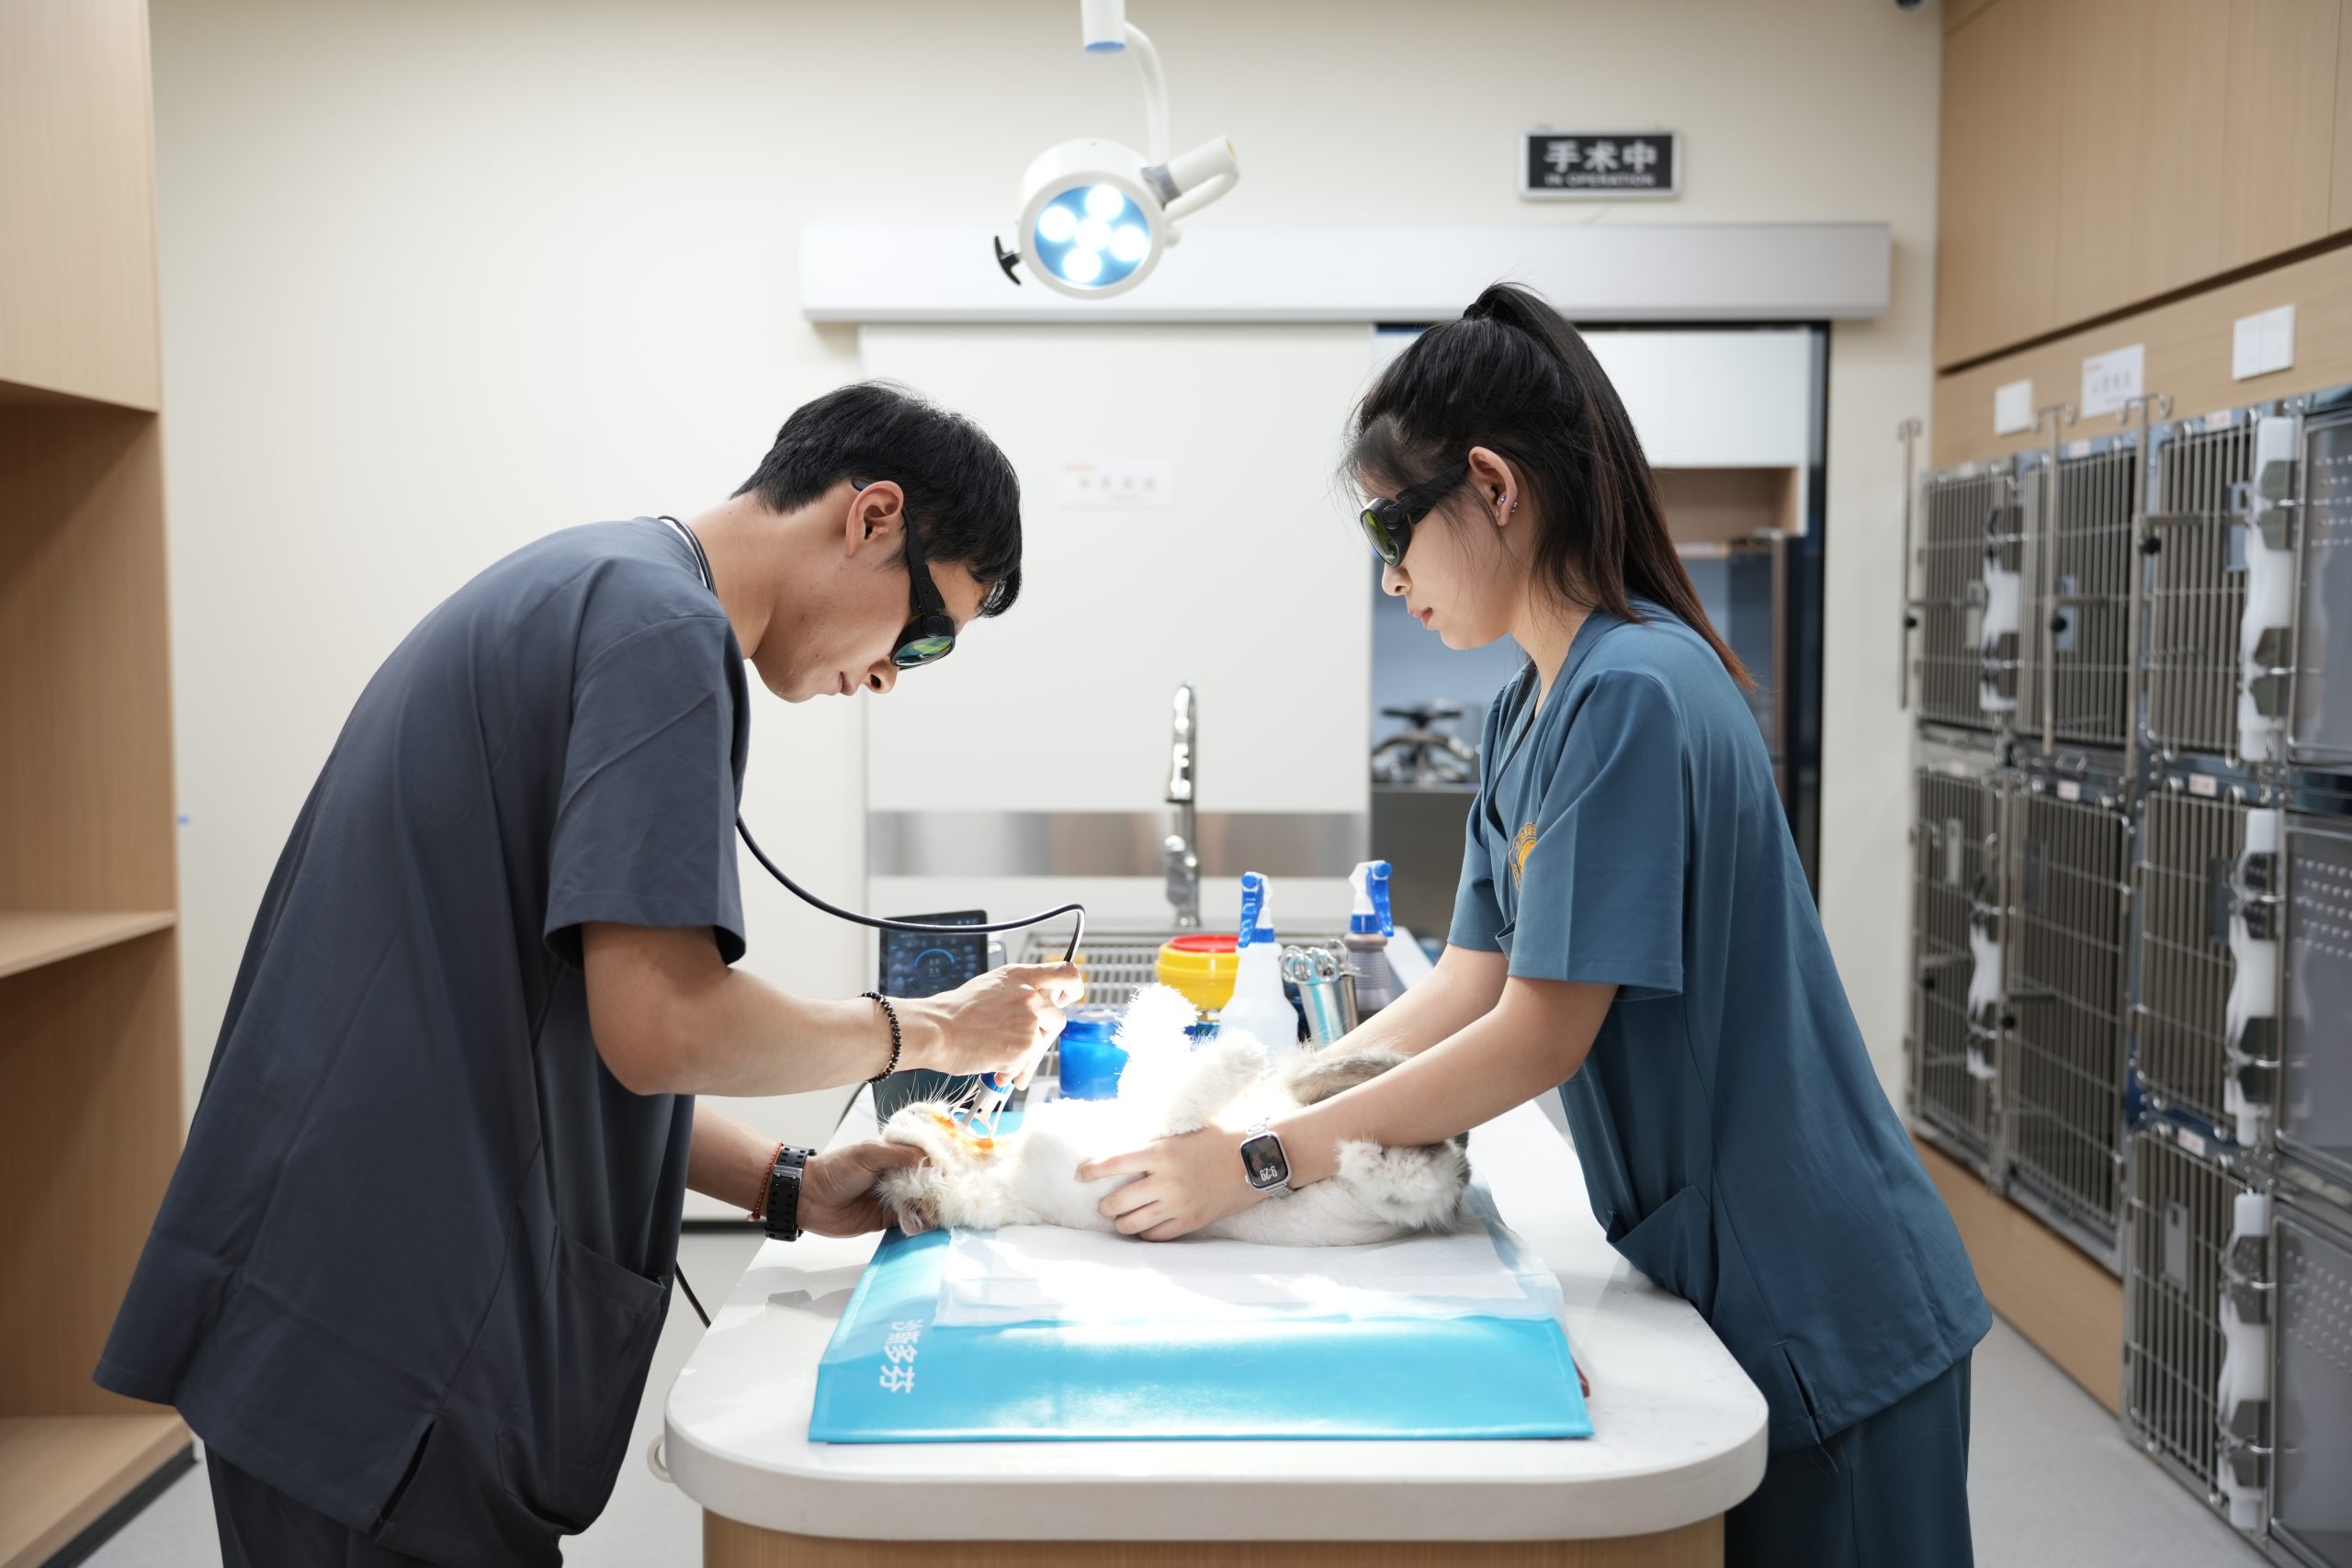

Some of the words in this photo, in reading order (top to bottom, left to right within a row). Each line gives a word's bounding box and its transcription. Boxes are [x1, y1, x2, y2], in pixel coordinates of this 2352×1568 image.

[1544, 140, 1657, 174] 手术中
[1260, 1166, 1278, 1181] 9:29
